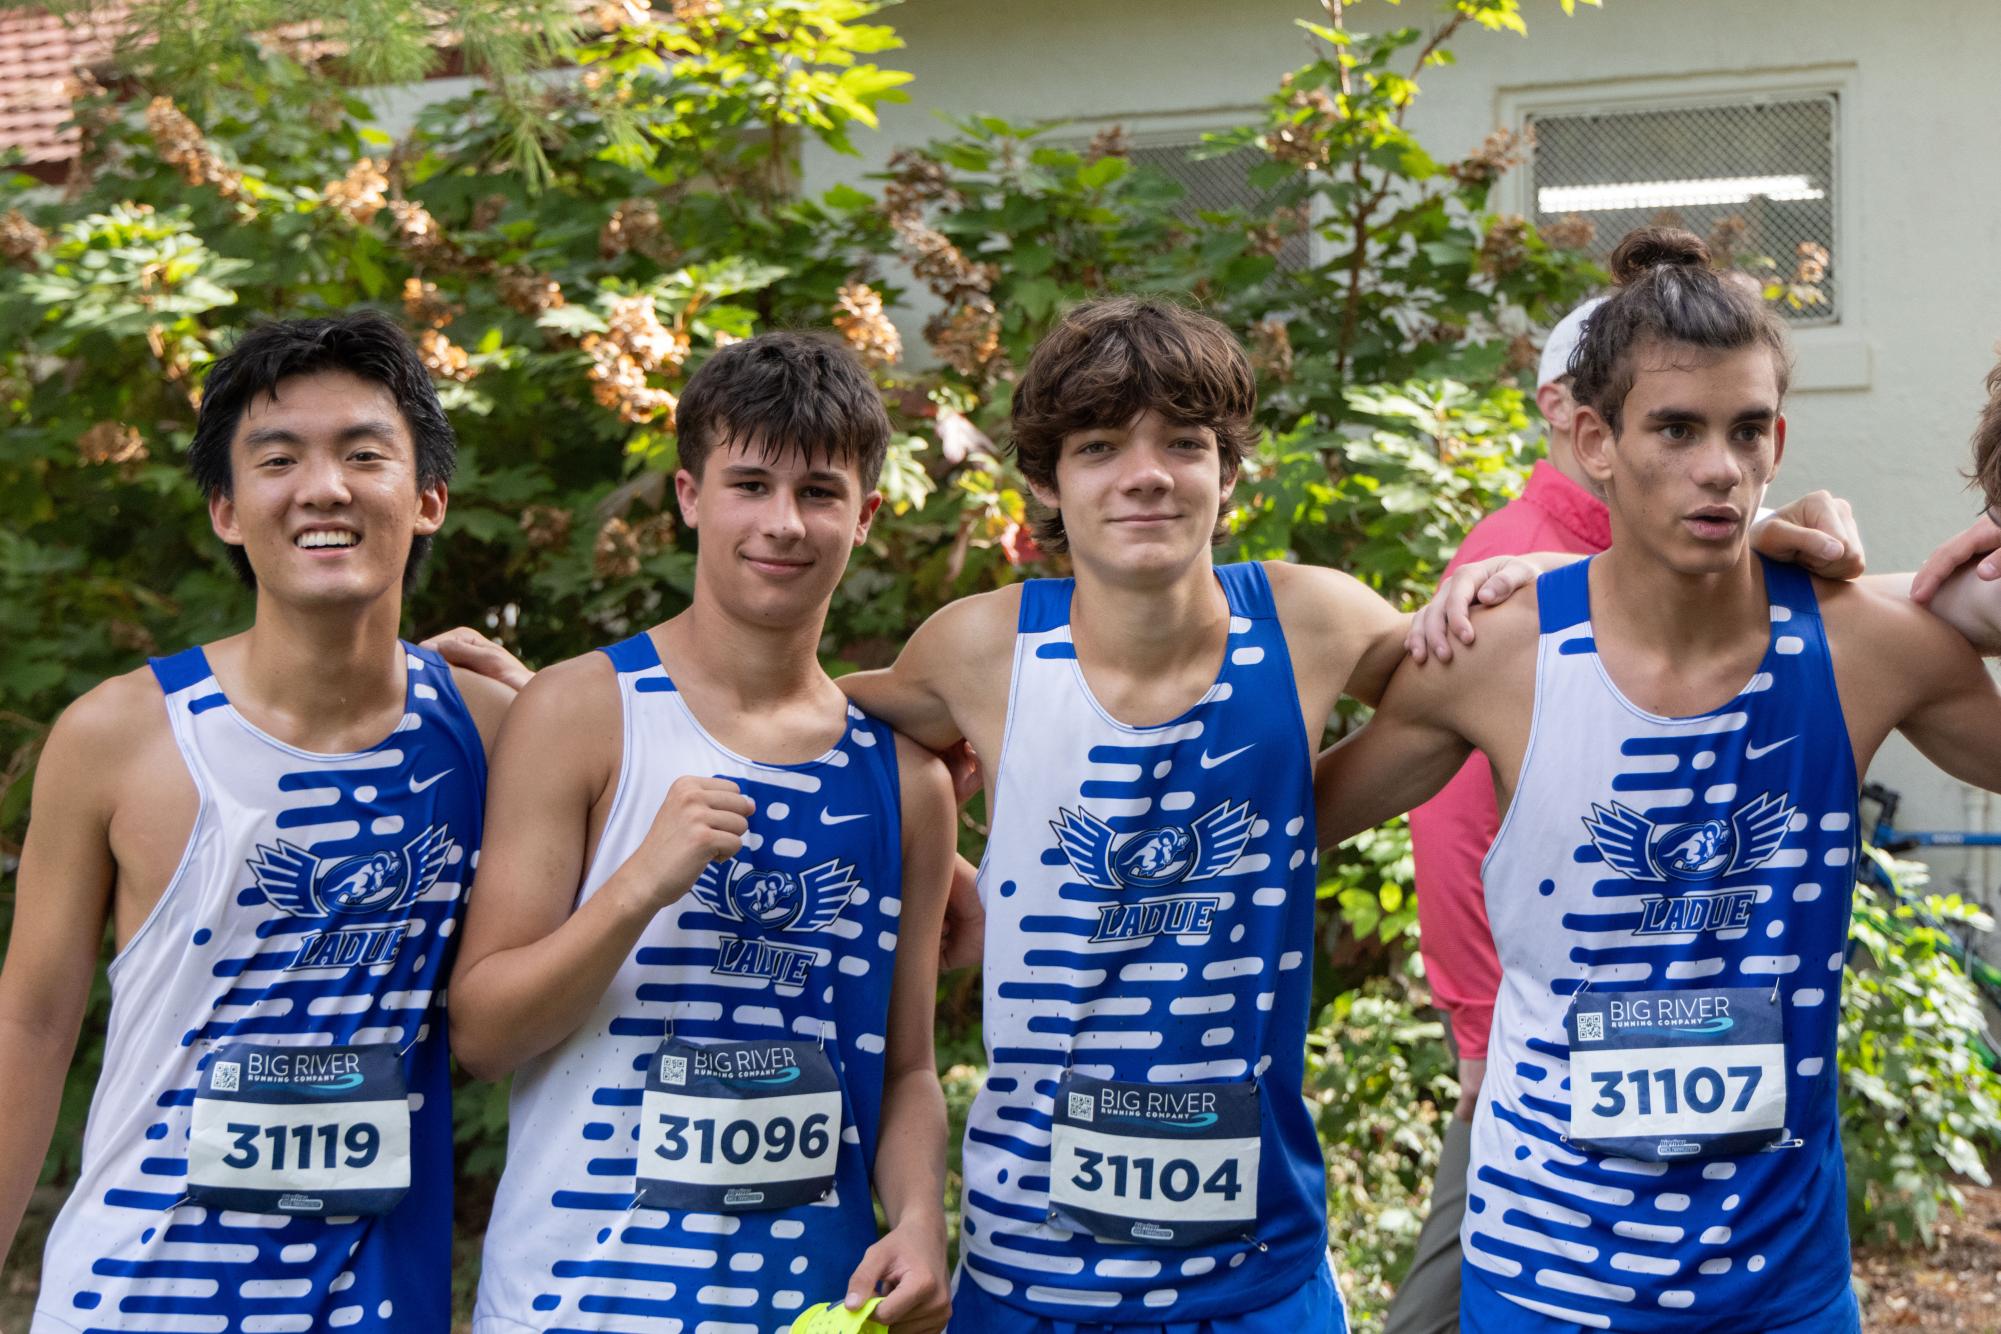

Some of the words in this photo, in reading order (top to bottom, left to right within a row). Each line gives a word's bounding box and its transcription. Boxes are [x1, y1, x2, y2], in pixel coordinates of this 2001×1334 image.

[1088, 897, 1220, 943] LADUE
[1632, 890, 1757, 936] LADUE
[282, 923, 411, 972] LADUE
[1610, 1000, 1651, 1021] BIG
[1658, 996, 1730, 1018] RIVER
[1611, 1019, 1653, 1028] RUNNING
[1658, 1018, 1703, 1026] COMPANY
[248, 1053, 289, 1076] BIG
[295, 1053, 360, 1074] RIVER
[694, 1050, 732, 1072] BIG
[736, 1048, 797, 1070] RIVER
[248, 1075, 289, 1083] RUNNING
[694, 1069, 734, 1078] RUNNING
[738, 1069, 776, 1078] COMPANY
[1101, 1088, 1140, 1110] BIG
[1148, 1093, 1216, 1113] RIVER
[1591, 1066, 1763, 1118] 31107
[1101, 1108, 1141, 1117] RUNNING
[1146, 1111, 1190, 1120] COMPANY
[222, 1122, 380, 1170] 31119
[654, 1113, 830, 1165] 31096
[1071, 1147, 1242, 1202] 31104
